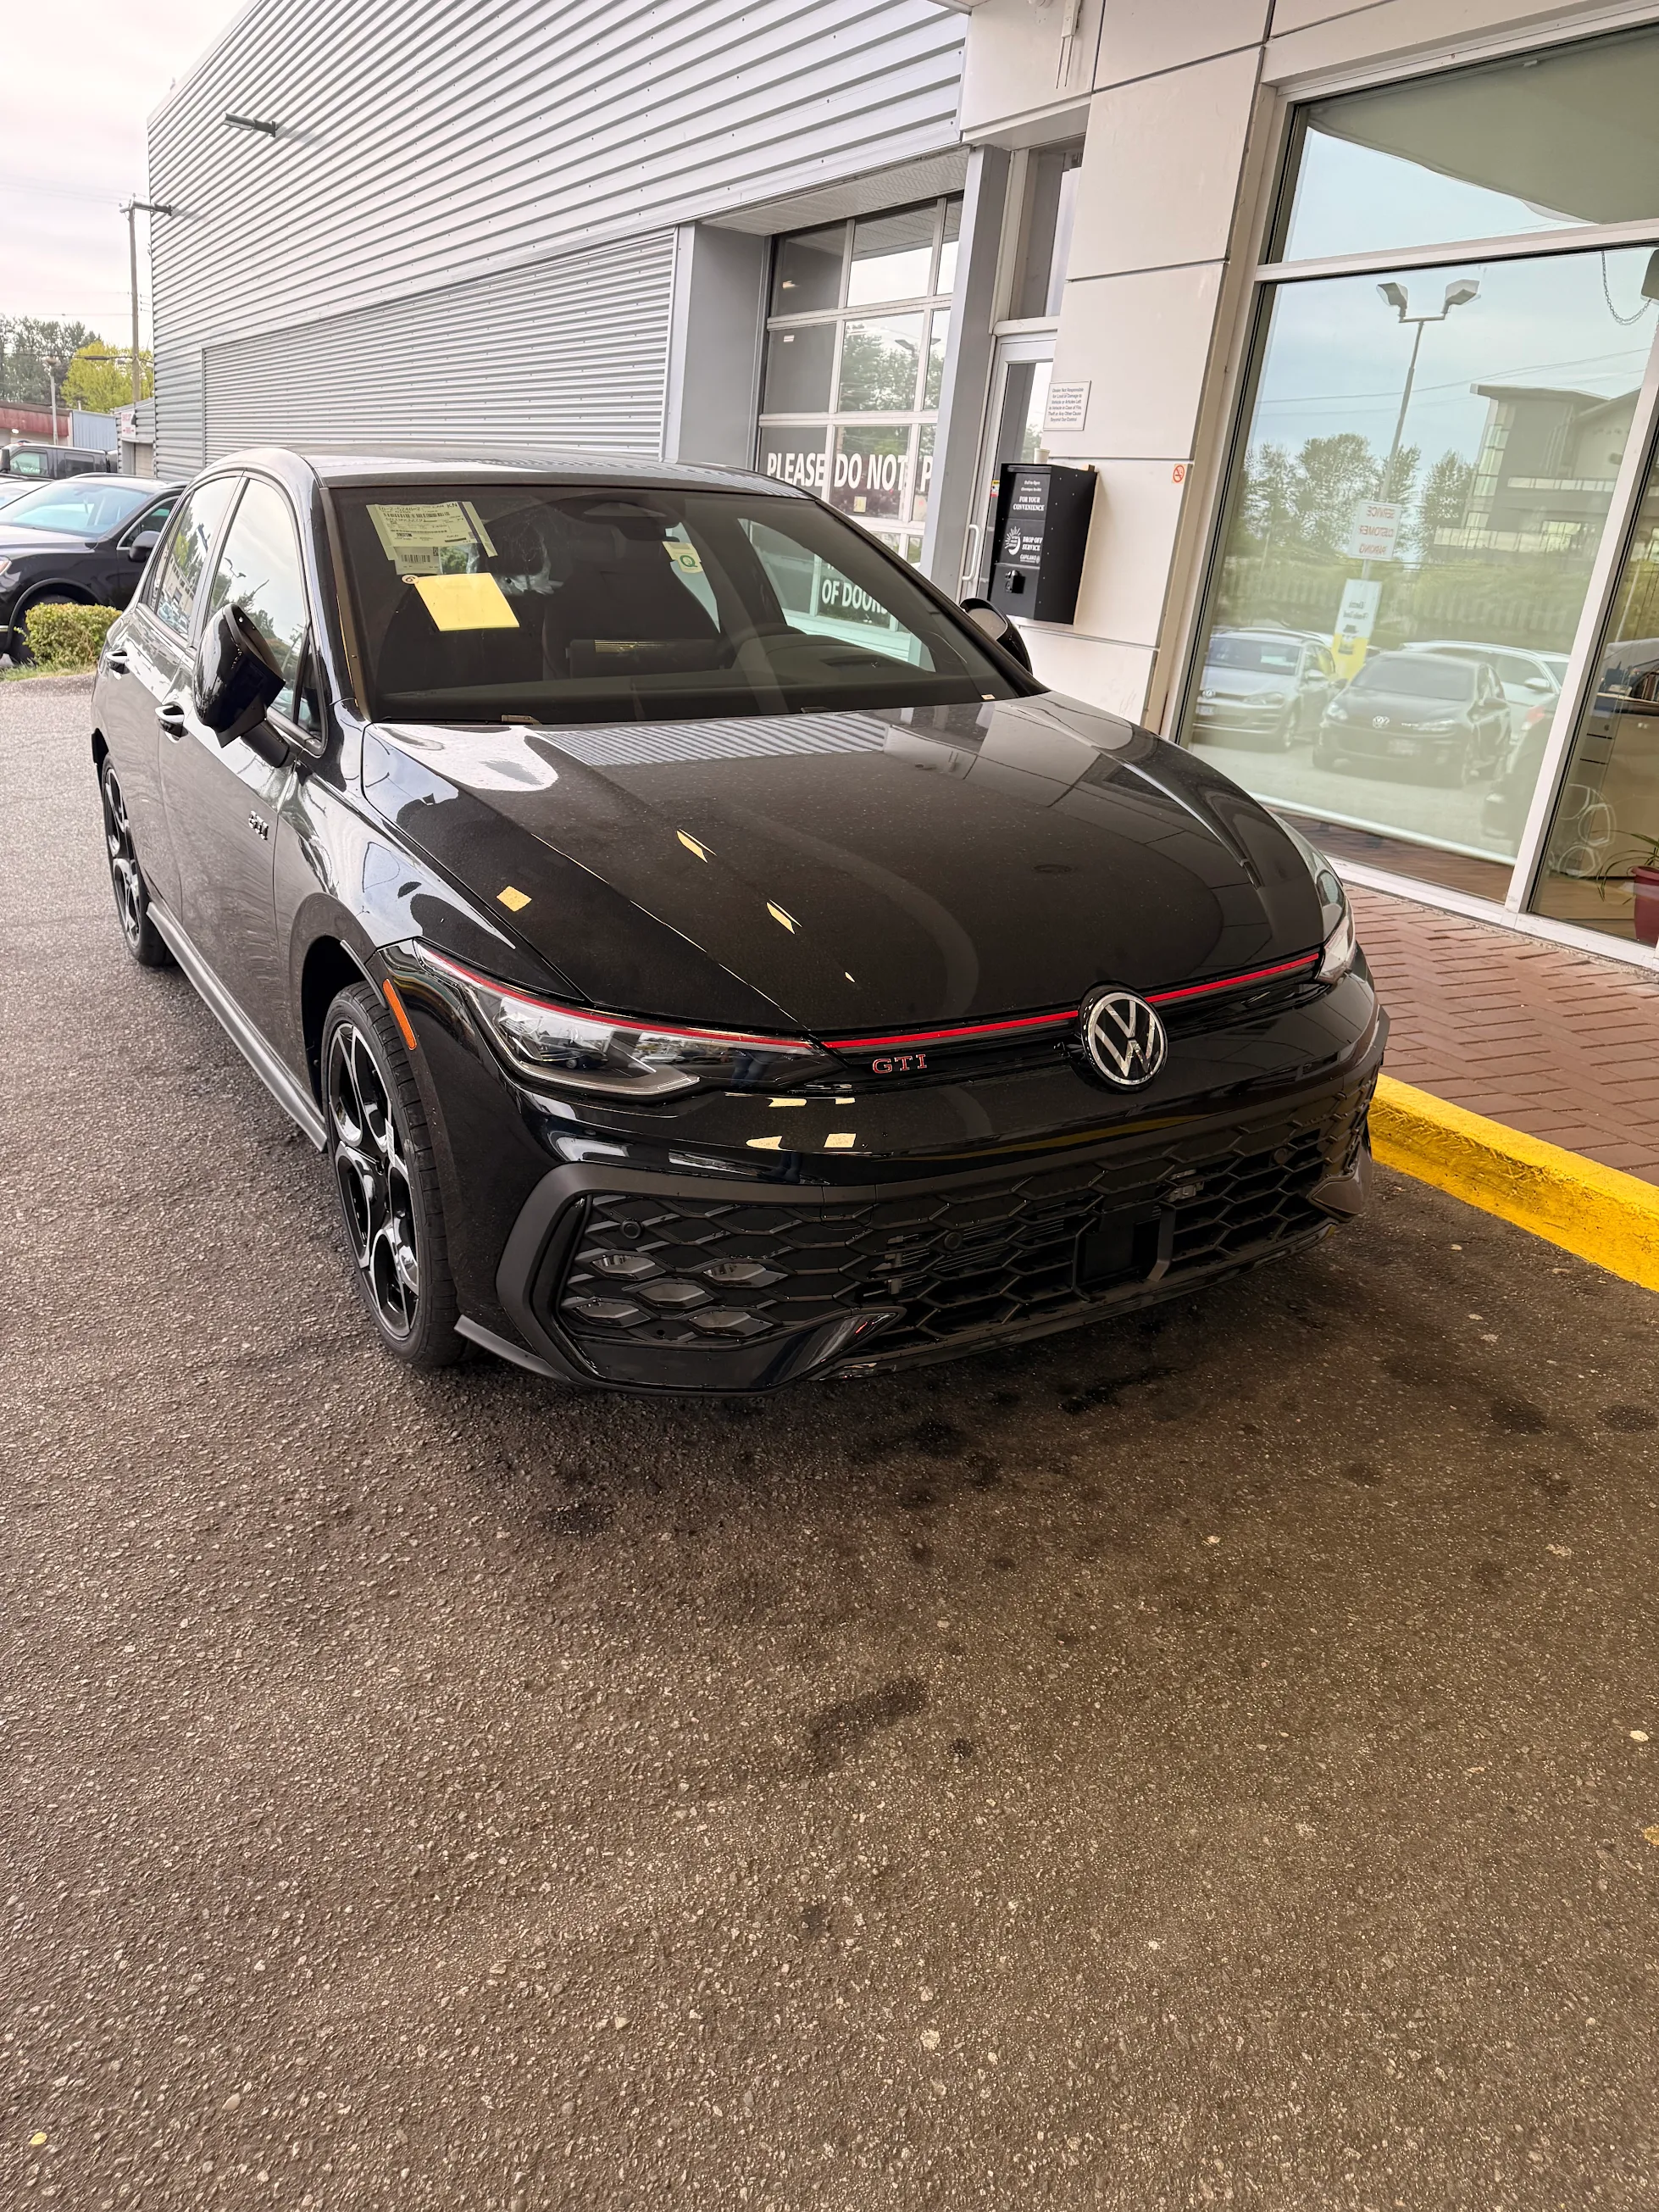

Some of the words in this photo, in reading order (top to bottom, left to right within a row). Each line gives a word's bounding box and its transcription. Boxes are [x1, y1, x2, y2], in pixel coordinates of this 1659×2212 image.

[767, 453, 825, 487] PLEASE
[834, 453, 863, 489] DO
[867, 454, 908, 492] NOT
[822, 580, 840, 605] OF
[872, 1053, 927, 1074] GTI
